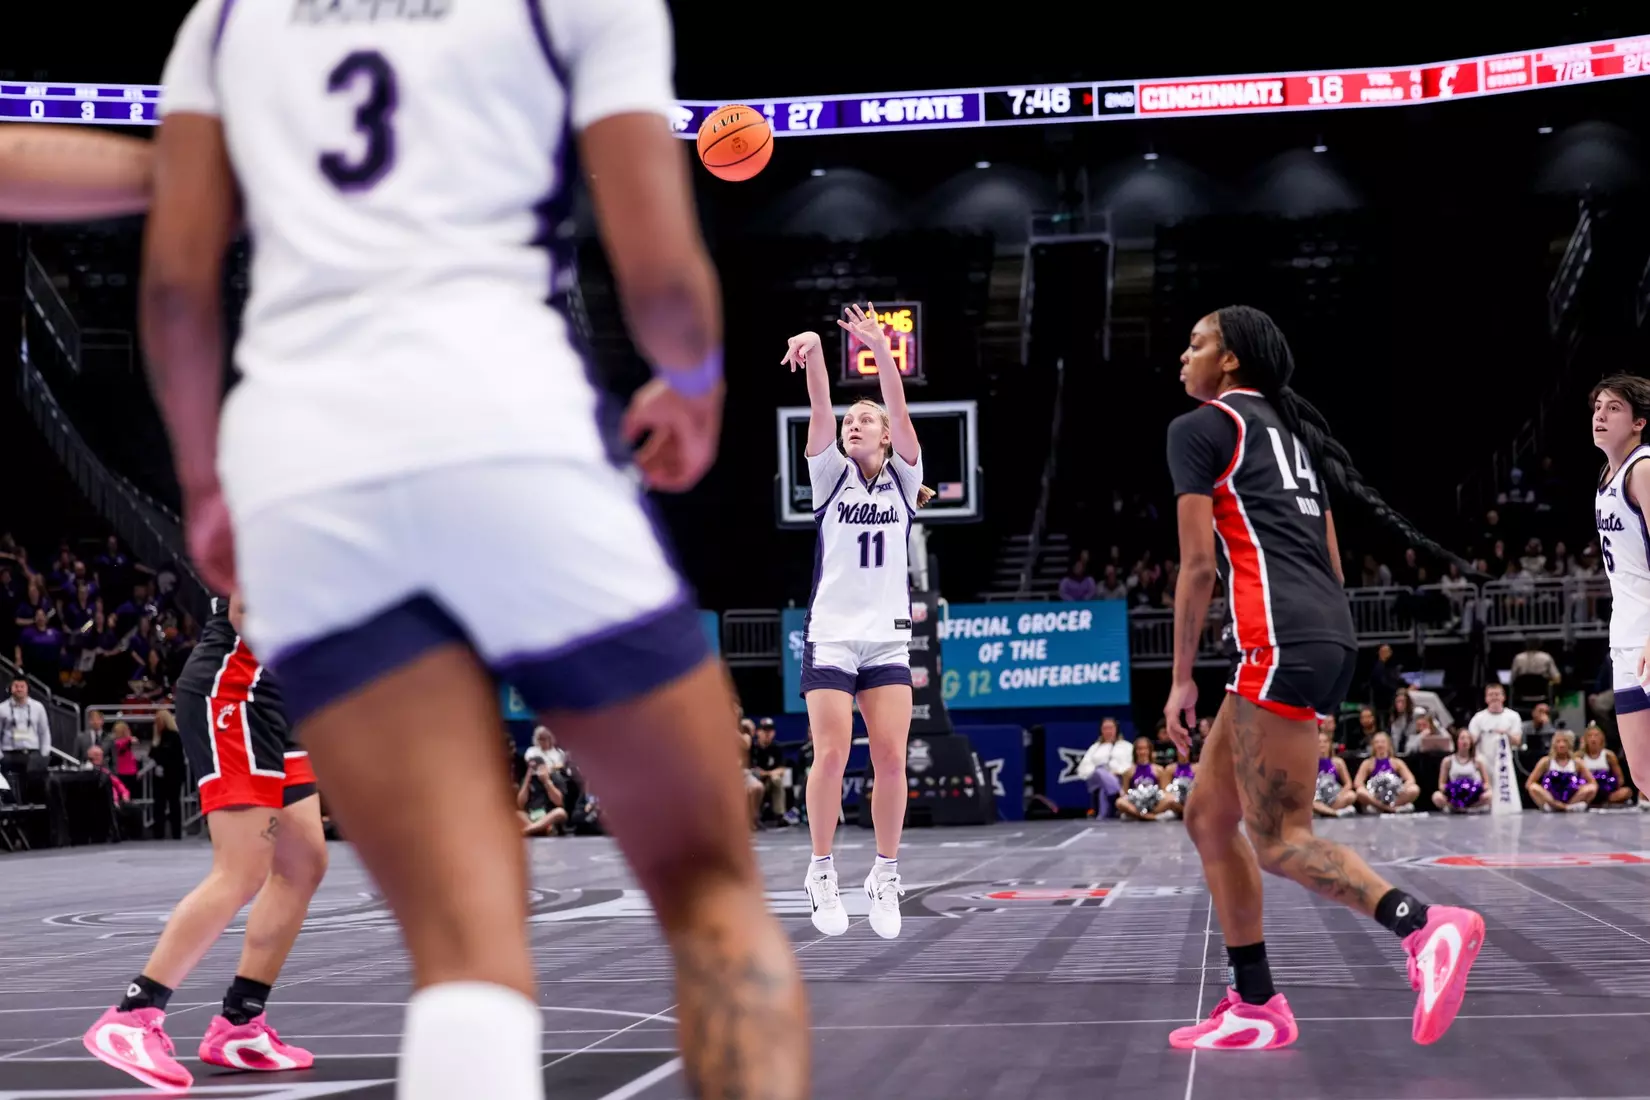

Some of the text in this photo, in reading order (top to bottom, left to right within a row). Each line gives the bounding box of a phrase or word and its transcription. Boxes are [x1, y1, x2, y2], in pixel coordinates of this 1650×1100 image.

[1007, 86, 1071, 116] 7:46
[1141, 80, 1284, 111] CINCINNATI
[1307, 76, 1343, 104] 16
[30, 100, 144, 121] 0 3 2
[320, 50, 400, 192] 3
[787, 102, 823, 130] 27
[860, 96, 964, 124] K-STATE
[1266, 427, 1320, 494] 14
[857, 530, 885, 569] 11
[1602, 535, 1615, 574] 6
[1017, 609, 1093, 635] GROCER
[978, 638, 1048, 664] OF THE
[968, 669, 992, 697] 12
[999, 661, 1121, 690] CONFERENCE
